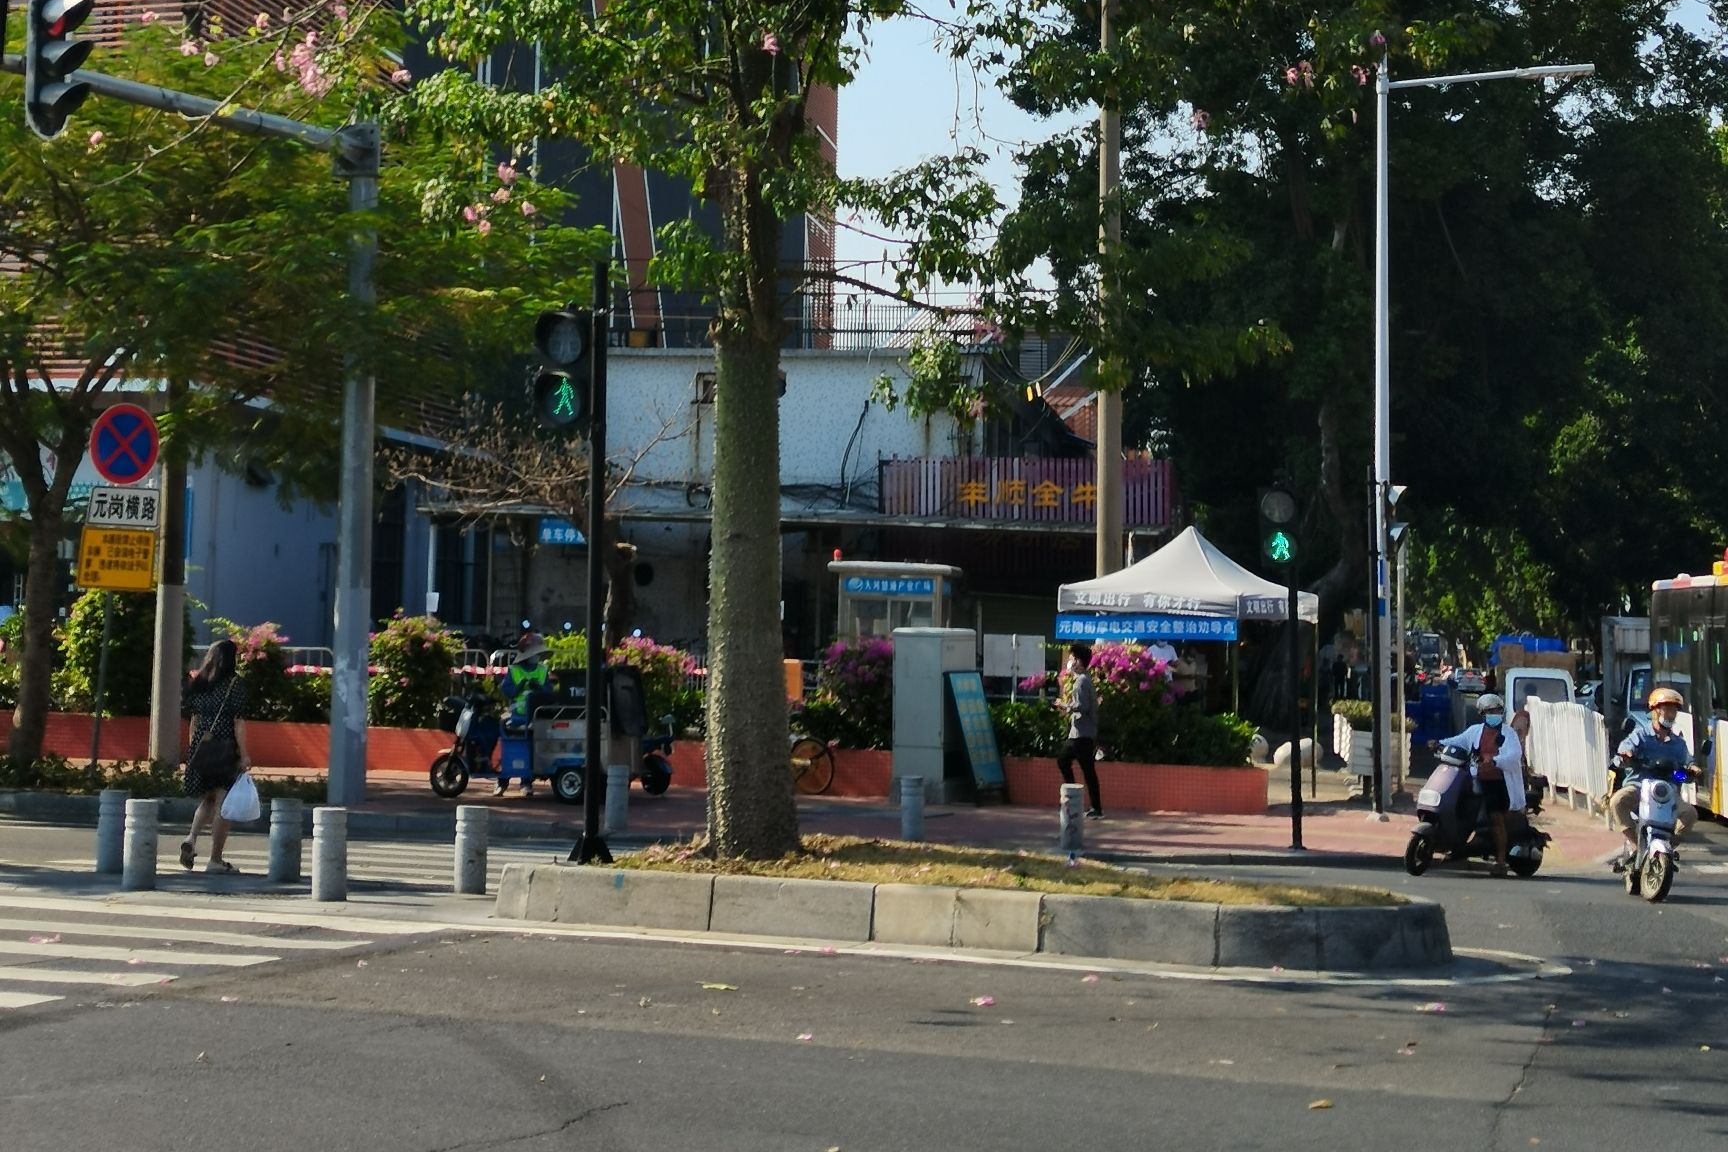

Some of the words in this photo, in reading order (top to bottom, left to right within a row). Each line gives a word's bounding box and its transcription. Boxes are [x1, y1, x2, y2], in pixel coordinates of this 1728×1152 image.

[93, 493, 156, 521] 元岗横路
[1074, 591, 1131, 607] 文明出行
[1142, 593, 1200, 610] 有你才行
